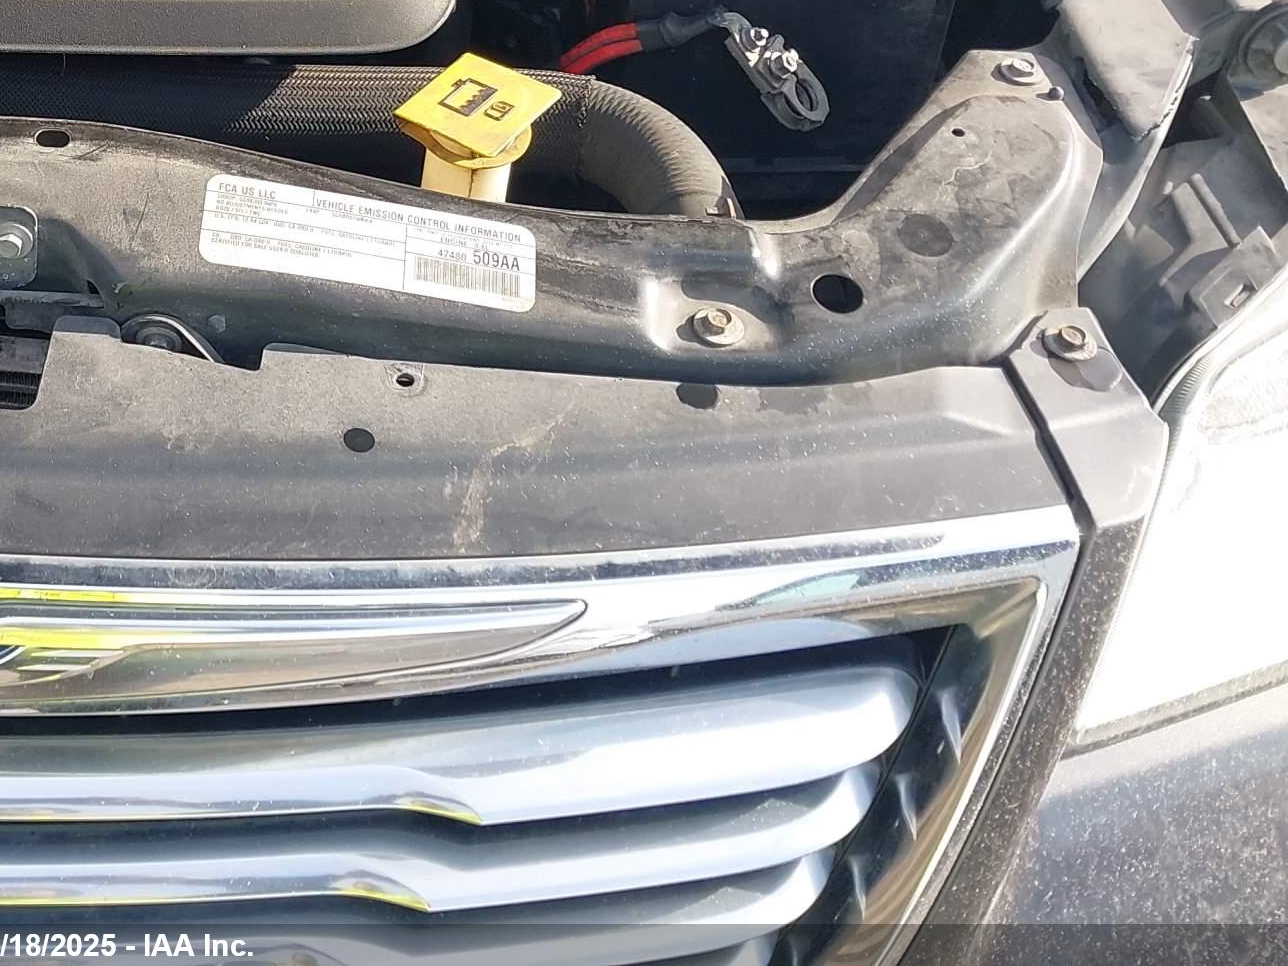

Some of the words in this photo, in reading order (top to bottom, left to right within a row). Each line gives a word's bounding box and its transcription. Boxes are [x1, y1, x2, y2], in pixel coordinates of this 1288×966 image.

[218, 182, 240, 195] FCA
[241, 185, 255, 197] US
[257, 188, 276, 200] LLC
[316, 198, 355, 214] VEHICLE
[357, 206, 404, 223] EMISSION
[407, 214, 451, 231] CONTROL
[454, 222, 522, 243] INFORMATION
[472, 249, 521, 272] 509AA
